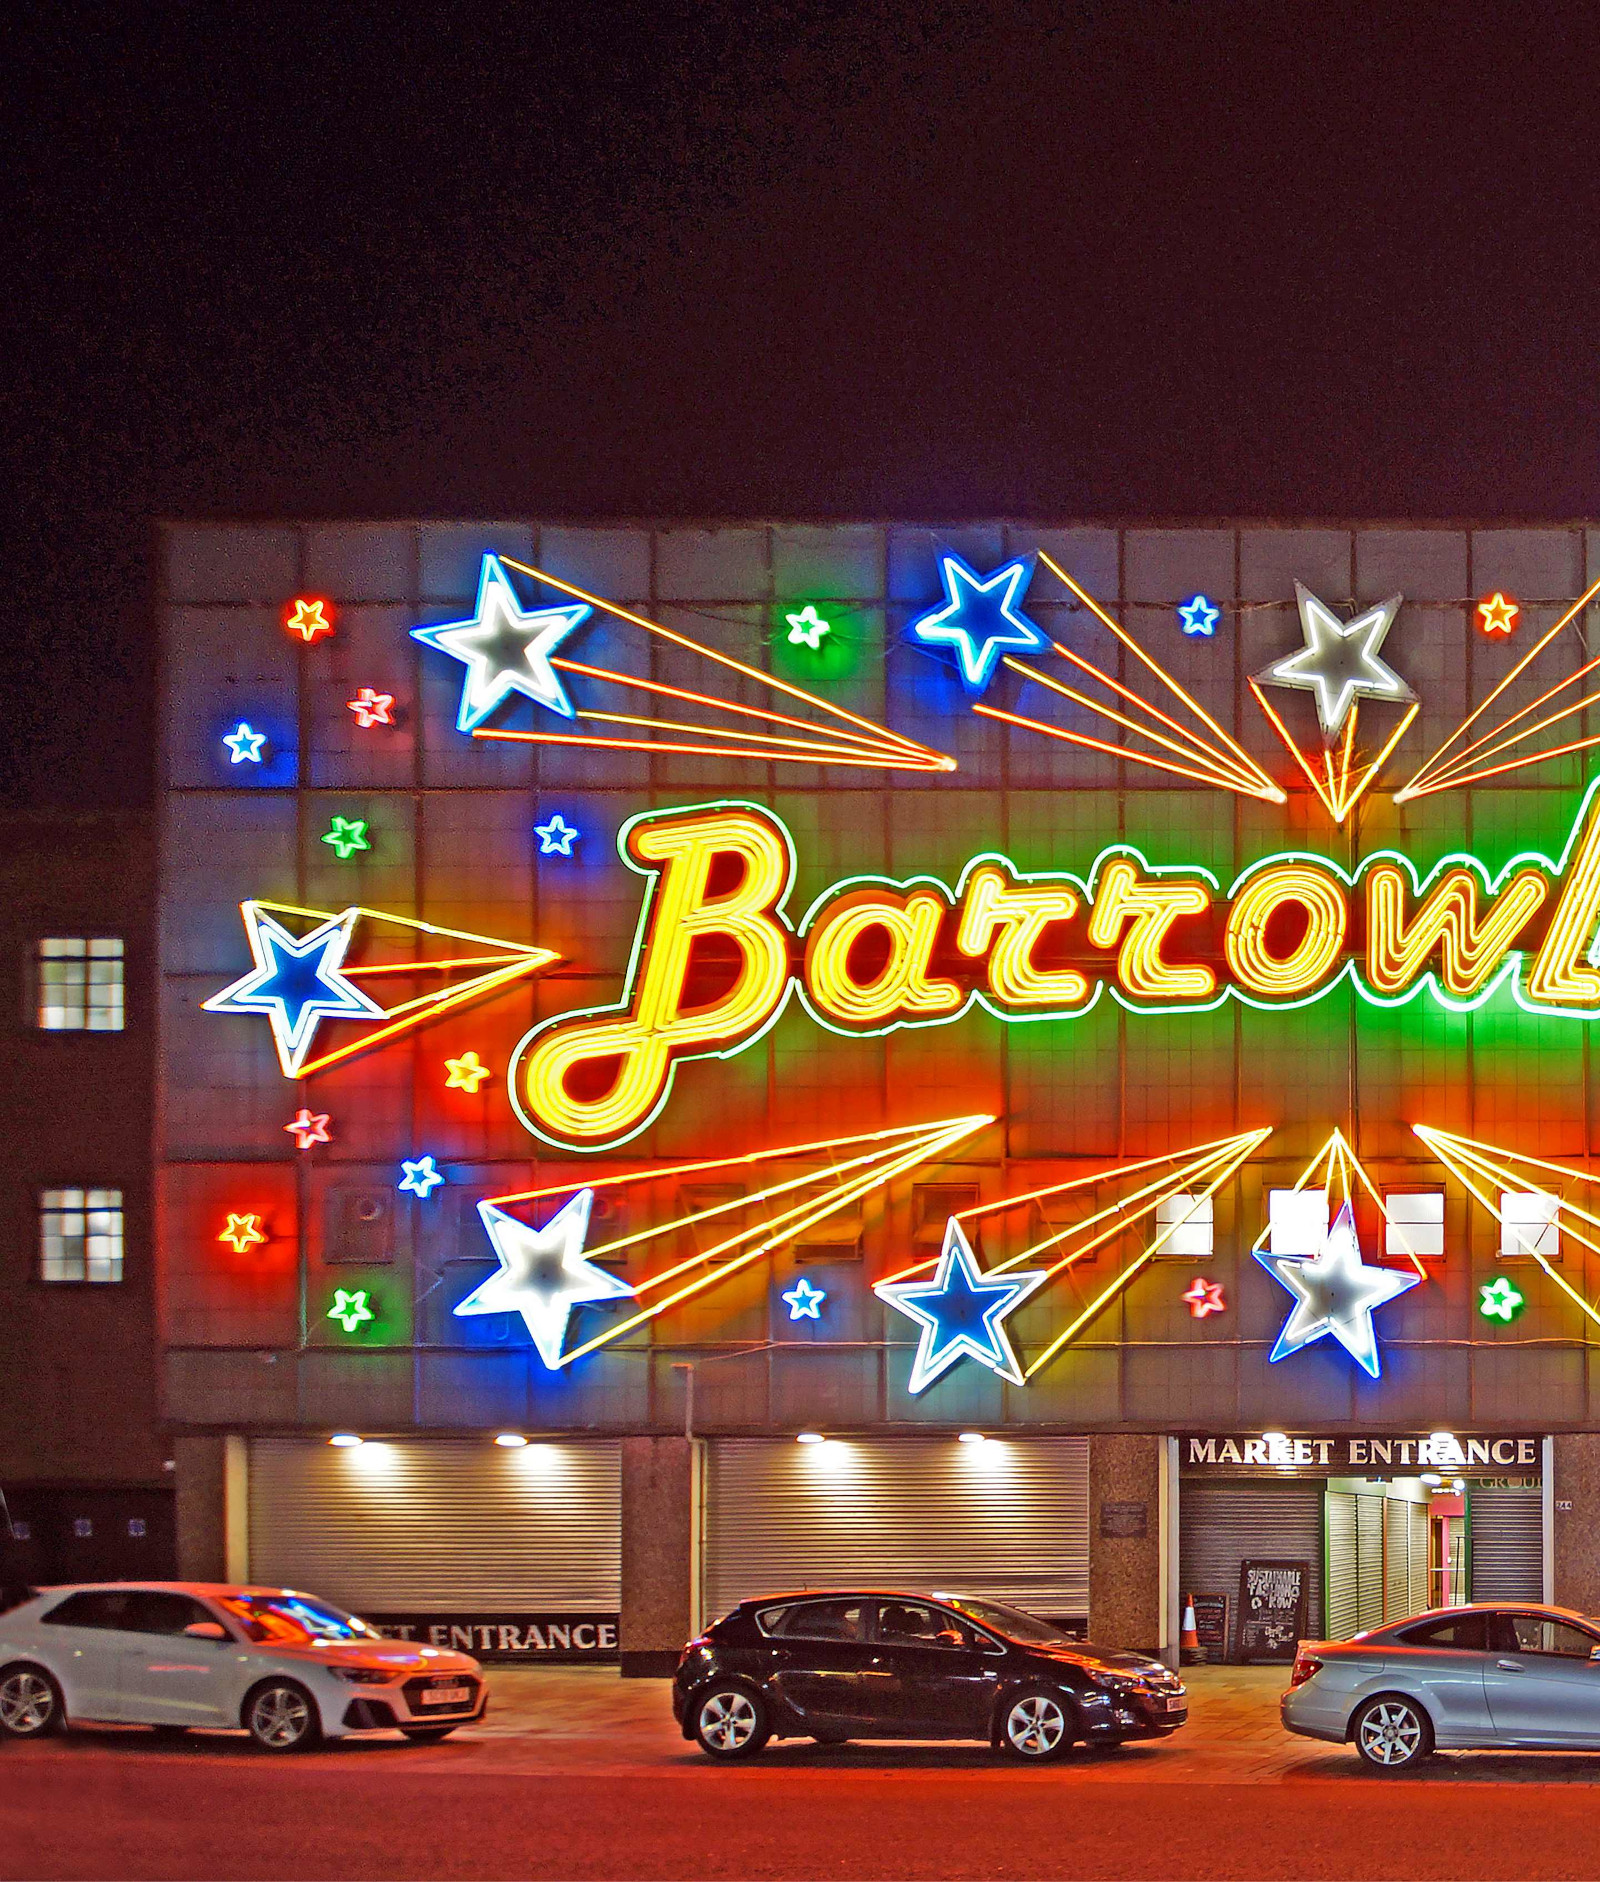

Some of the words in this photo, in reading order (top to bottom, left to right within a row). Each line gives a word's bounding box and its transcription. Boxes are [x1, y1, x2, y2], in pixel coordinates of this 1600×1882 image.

[1188, 1438, 1335, 1465] MARKET
[1348, 1438, 1537, 1465] ENTRANCE
[429, 1624, 618, 1650] ENTRANCE
